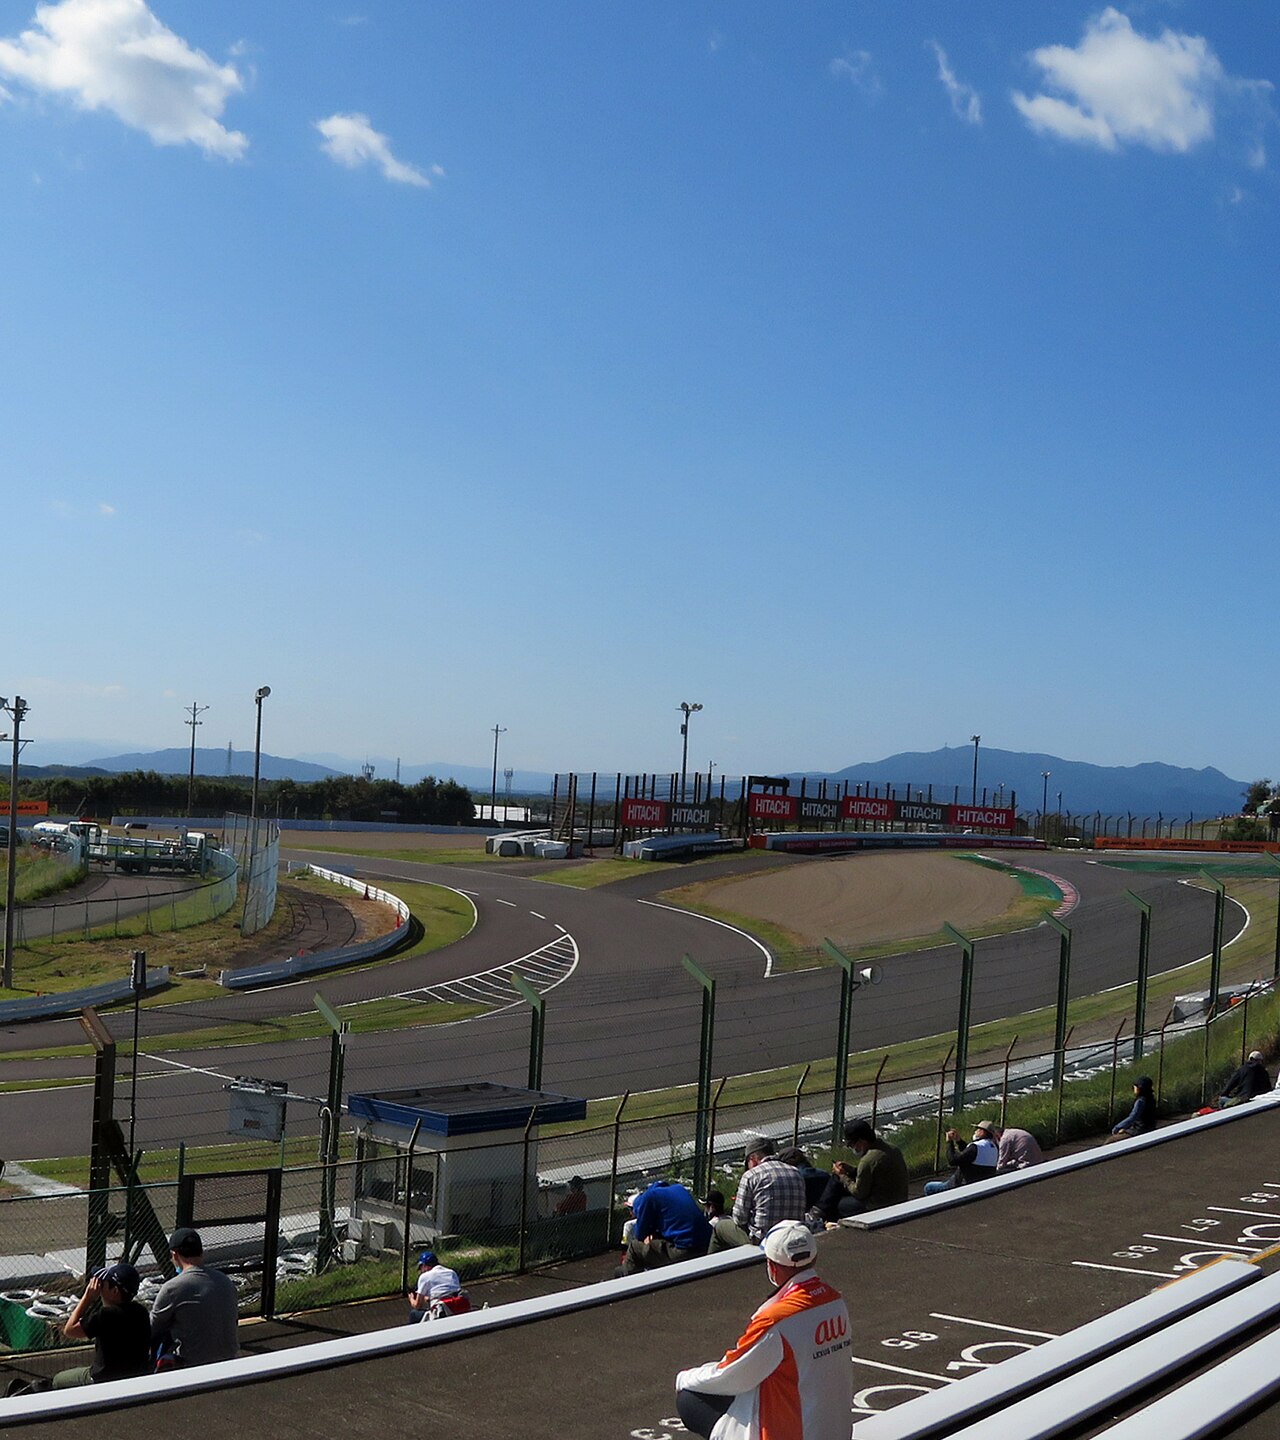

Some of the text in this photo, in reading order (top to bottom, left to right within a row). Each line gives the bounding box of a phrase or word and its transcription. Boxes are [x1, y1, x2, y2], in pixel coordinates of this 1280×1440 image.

[628, 806, 710, 824] HITACHI HITACHI
[756, 799, 1006, 825] HITACHI HITACHI HITACHI HITACHI HITACHI
[1180, 1218, 1221, 1232] 67
[815, 1314, 847, 1345] au
[881, 1329, 939, 1350] 65
[812, 1347, 831, 1360] LEXUS
